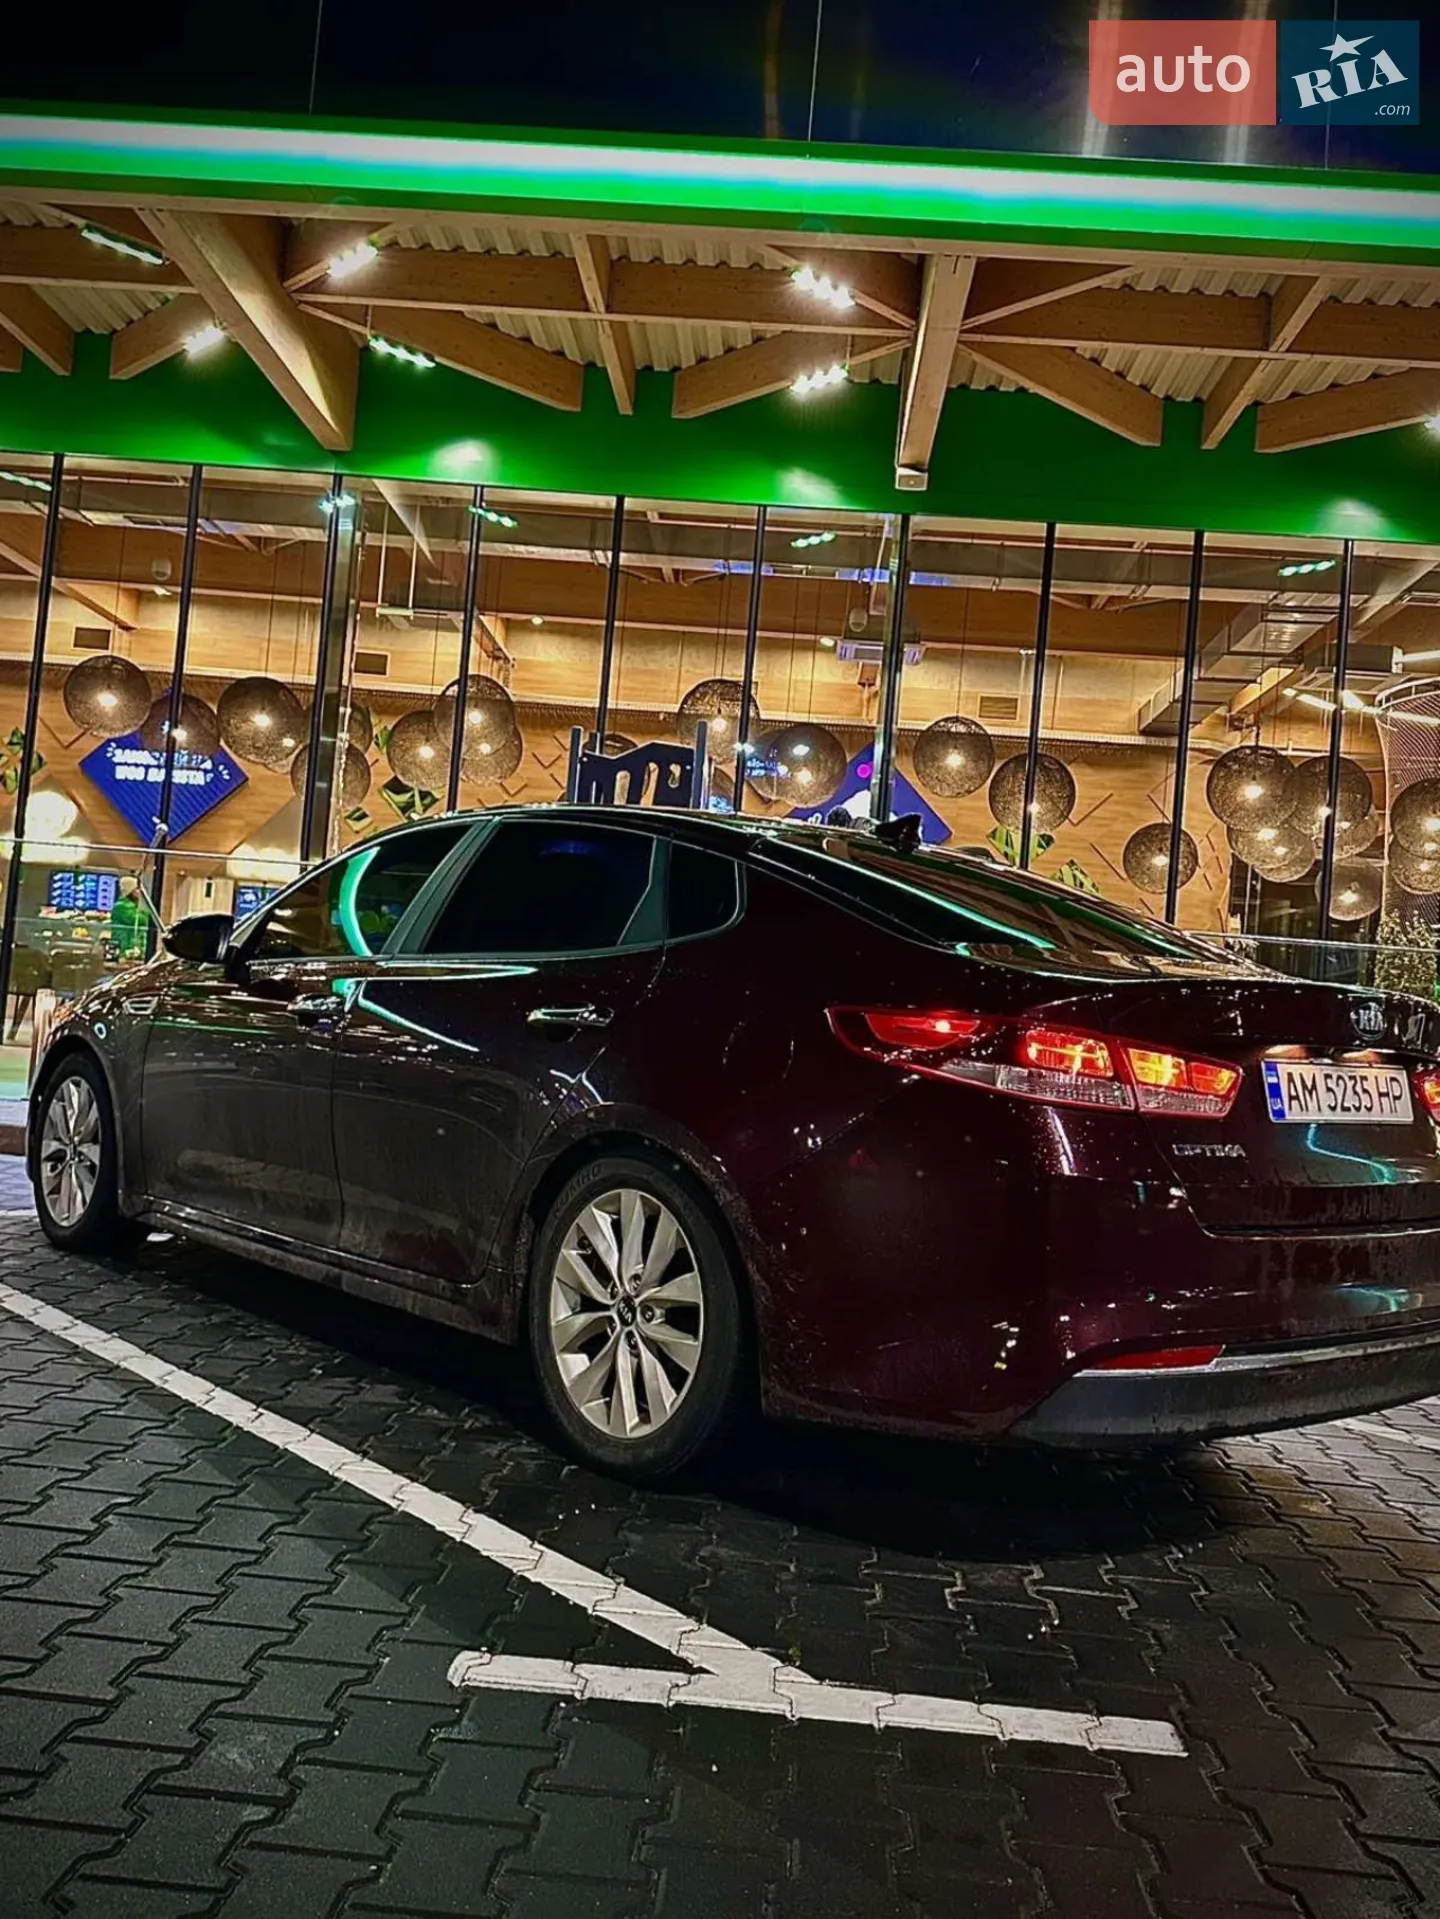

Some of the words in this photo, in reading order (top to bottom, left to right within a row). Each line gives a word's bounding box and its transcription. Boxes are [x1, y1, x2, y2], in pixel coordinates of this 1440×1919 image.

[1287, 1071, 1321, 1113] AM
[1324, 1073, 1373, 1112] 5235
[1375, 1075, 1403, 1115] HP
